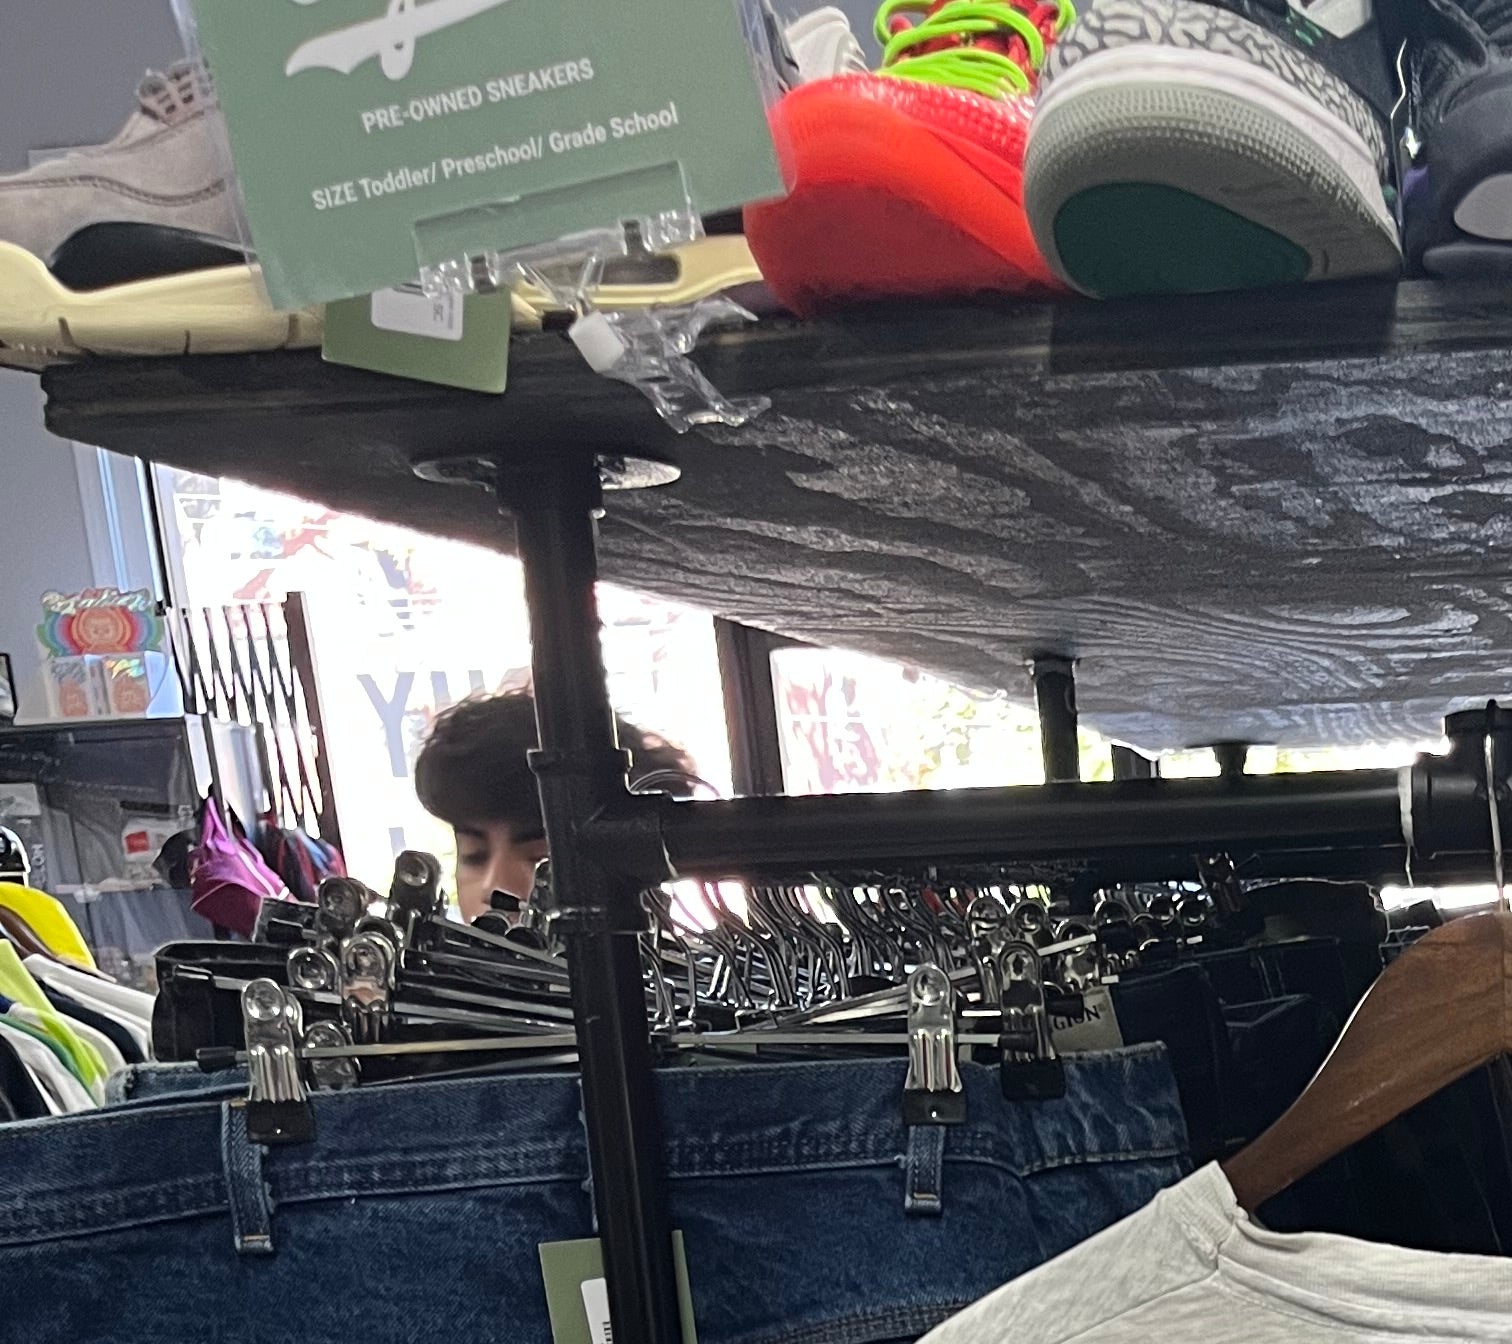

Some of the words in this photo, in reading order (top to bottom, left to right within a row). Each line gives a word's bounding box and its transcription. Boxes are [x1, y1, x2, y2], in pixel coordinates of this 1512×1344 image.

[360, 85, 483, 134] PRE-OWNED
[487, 58, 594, 103] SNEAKERS
[311, 181, 358, 211] SIZE
[359, 162, 437, 199] Toddler/
[441, 136, 544, 179] Preschool/
[548, 123, 607, 154] Grade
[610, 102, 680, 138] School
